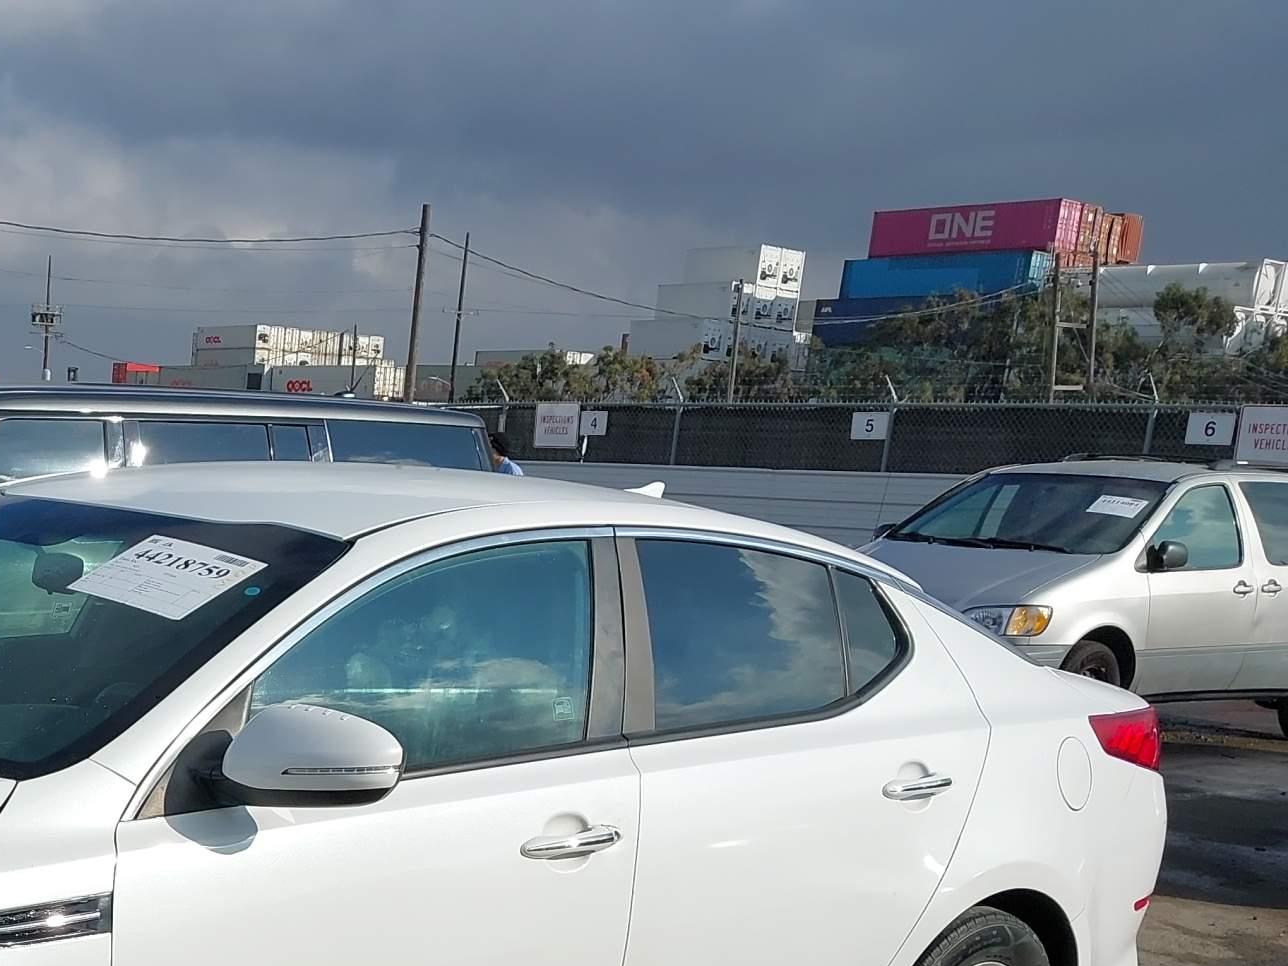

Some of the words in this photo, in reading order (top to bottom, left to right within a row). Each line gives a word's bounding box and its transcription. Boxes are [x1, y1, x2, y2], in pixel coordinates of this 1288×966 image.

[929, 210, 995, 240] ONE
[287, 380, 312, 392] OOCL
[590, 417, 598, 430] 4
[865, 419, 874, 433] 5
[1204, 421, 1216, 437] 6
[1248, 423, 1288, 434] INSPECT
[1254, 438, 1288, 450] VEHICL
[134, 548, 230, 579] 44218759
